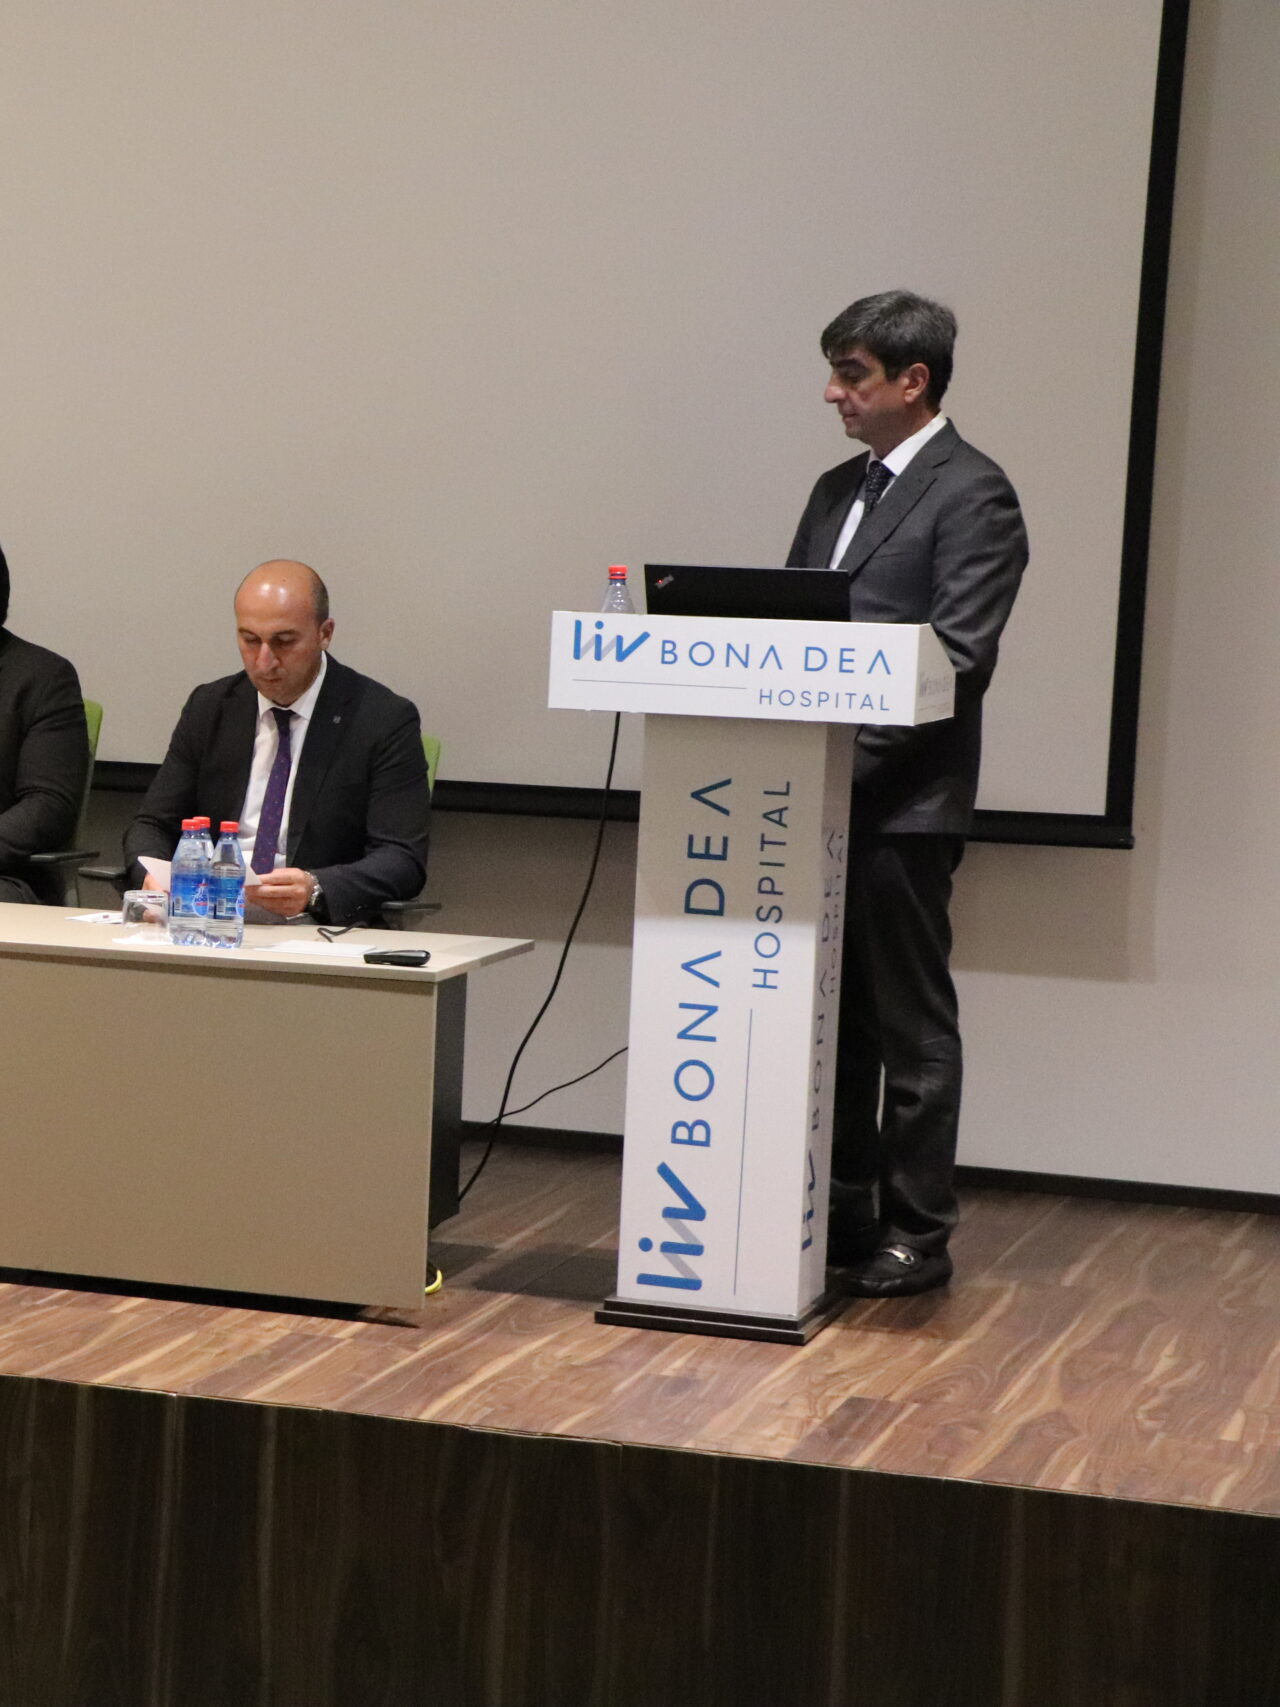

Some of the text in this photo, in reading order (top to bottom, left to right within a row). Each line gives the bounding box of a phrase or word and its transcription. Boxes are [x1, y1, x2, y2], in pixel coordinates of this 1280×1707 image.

[572, 619, 892, 676] liv BONA DEA
[759, 689, 890, 711] HOSPITAL
[752, 781, 791, 990] HOSPITAL
[636, 778, 732, 1291] liv BONA DEA
